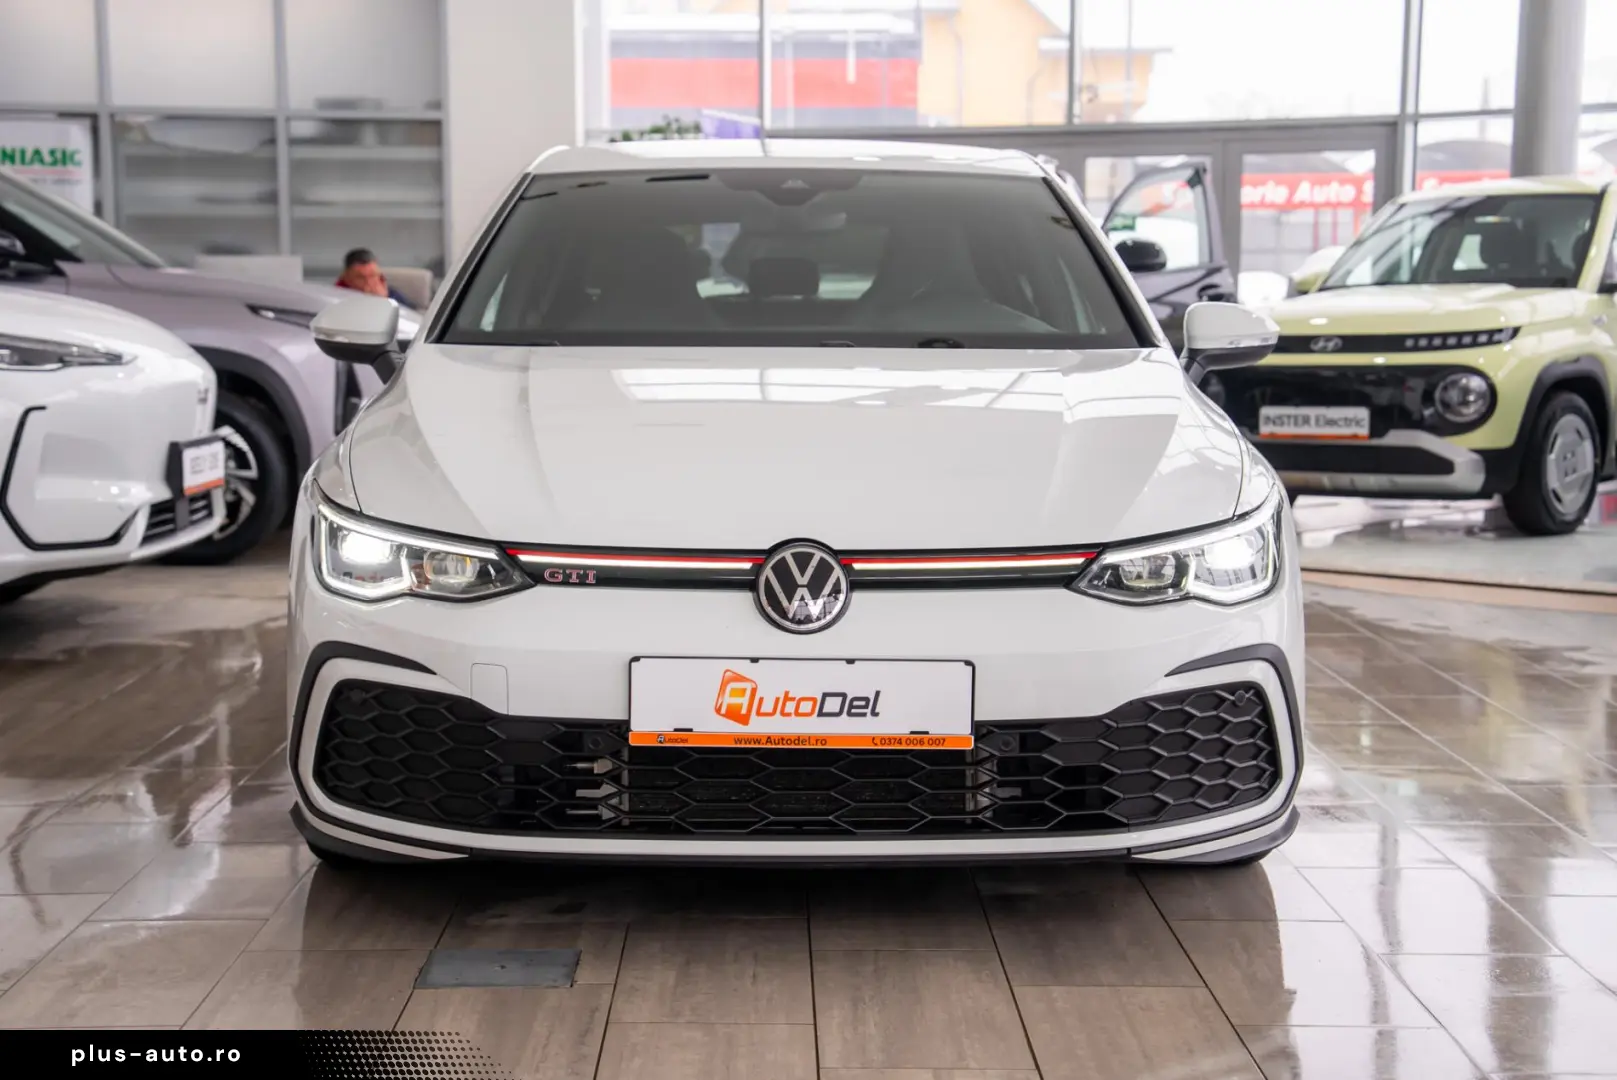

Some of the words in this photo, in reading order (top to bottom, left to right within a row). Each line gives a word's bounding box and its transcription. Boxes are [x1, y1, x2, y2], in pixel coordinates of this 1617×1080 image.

[1293, 180, 1356, 204] Auto
[1314, 414, 1366, 428] Electric
[544, 568, 597, 584] GTI
[715, 674, 881, 722] AutoDel
[733, 735, 828, 747] www.Autodel.ro
[880, 737, 903, 746] 0374
[905, 737, 926, 746] 006
[927, 737, 946, 746] 007
